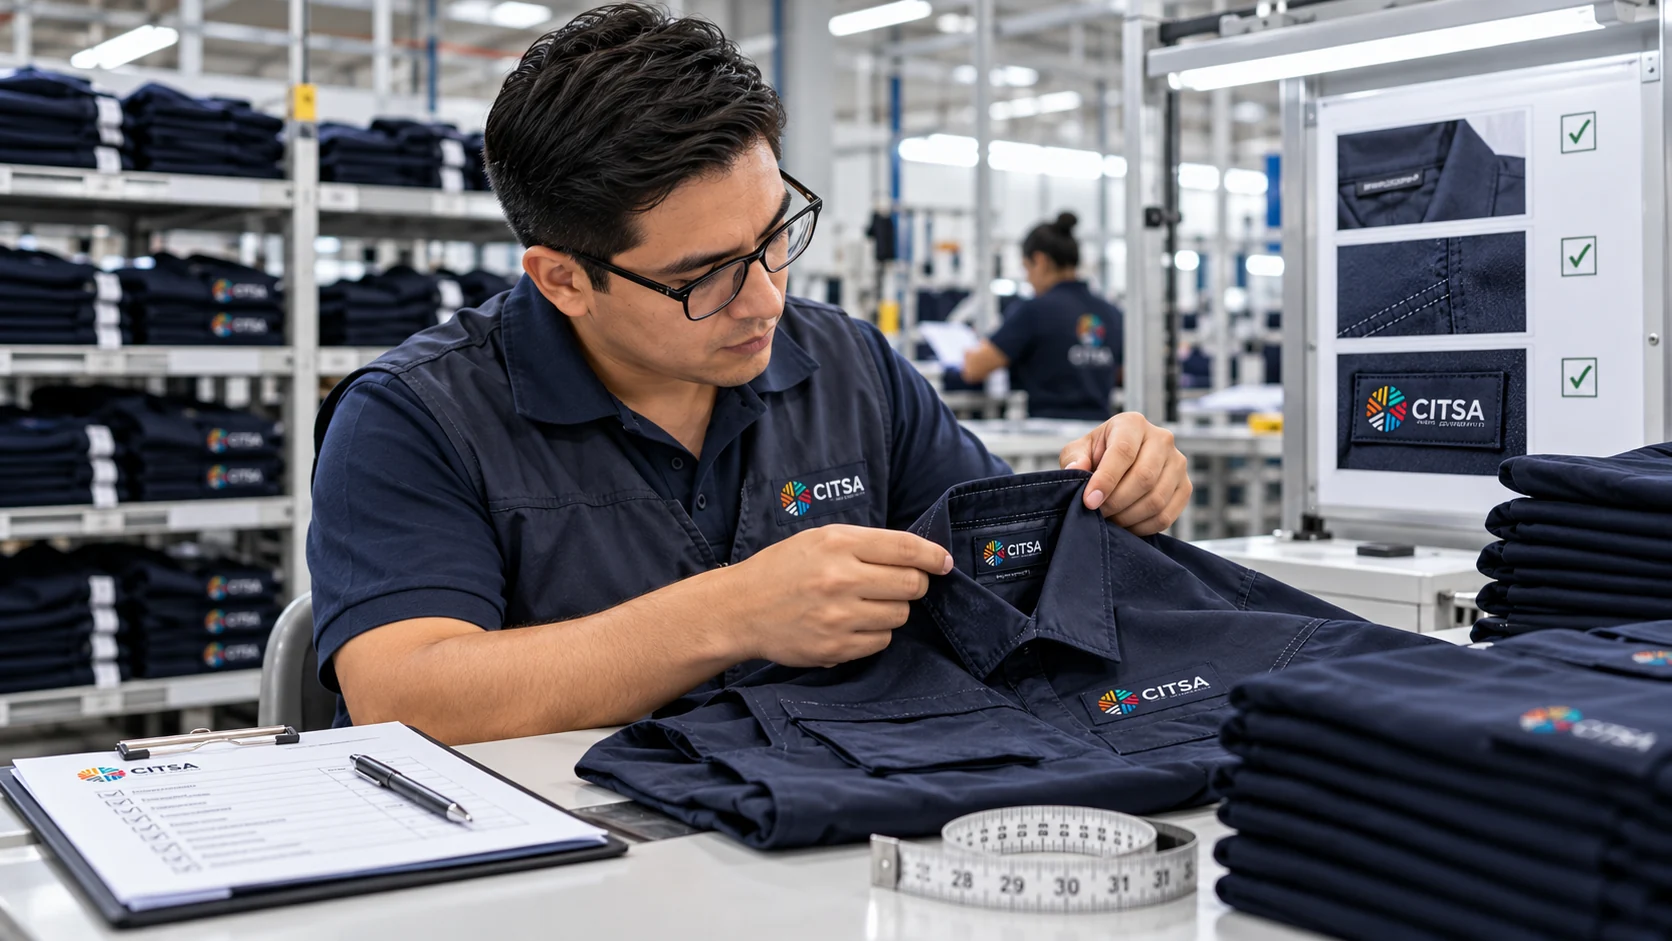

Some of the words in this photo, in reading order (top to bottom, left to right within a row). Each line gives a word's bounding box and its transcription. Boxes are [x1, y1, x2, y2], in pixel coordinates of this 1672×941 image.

[1412, 398, 1485, 421] CITSA
[813, 475, 865, 501] CITSA
[1007, 540, 1042, 556] CITSA
[1141, 675, 1210, 701] CITSA
[130, 762, 199, 775] CITSA
[951, 869, 973, 889] 28
[1000, 875, 1025, 895] 29
[1054, 877, 1080, 897] 30
[1108, 875, 1129, 895] 31
[1153, 869, 1170, 889] 31
